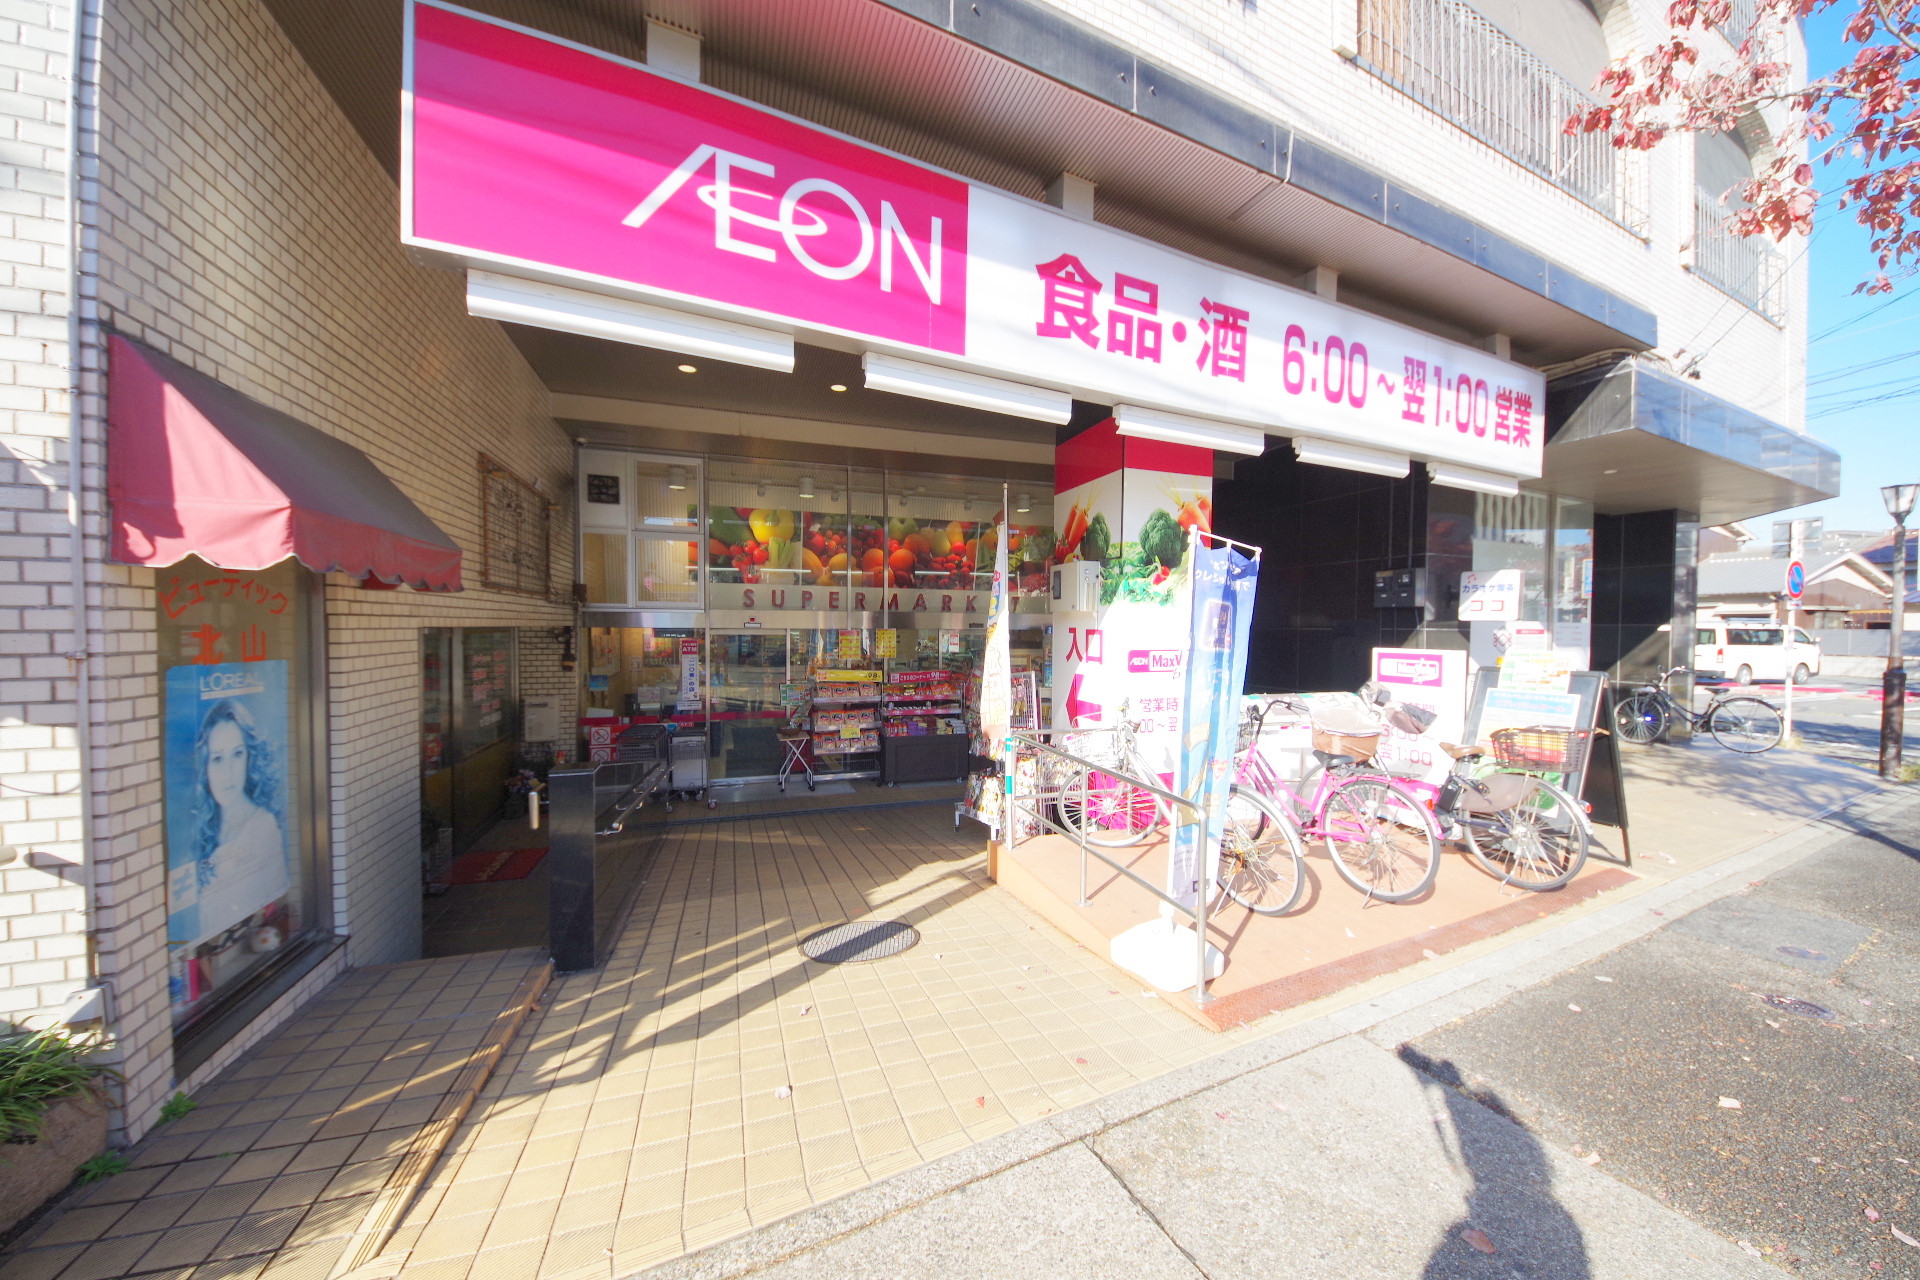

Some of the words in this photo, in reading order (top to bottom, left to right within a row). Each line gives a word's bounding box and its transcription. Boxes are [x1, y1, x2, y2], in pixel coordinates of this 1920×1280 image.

[621, 143, 943, 306] AEON
[1035, 252, 1250, 383] 食品・酒
[743, 589, 1020, 612] SUPERMARKT
[1470, 600, 1504, 612] ココ
[1066, 627, 1103, 665] 入口
[1129, 657, 1148, 666] AEON
